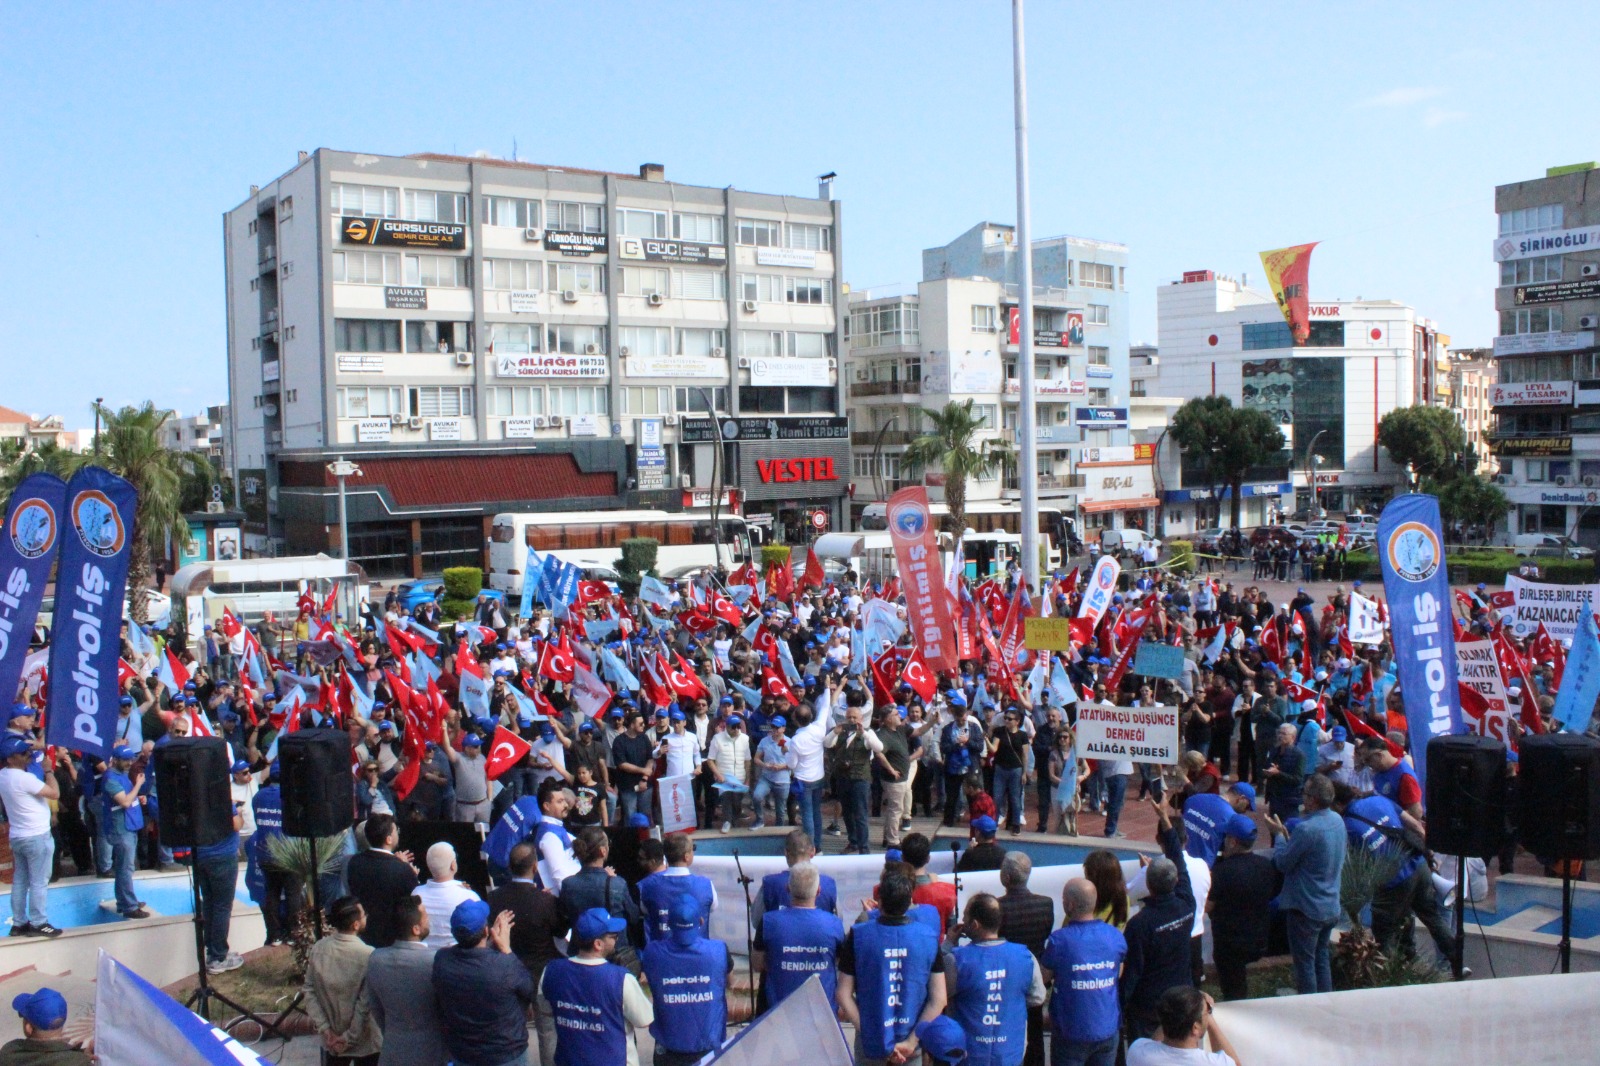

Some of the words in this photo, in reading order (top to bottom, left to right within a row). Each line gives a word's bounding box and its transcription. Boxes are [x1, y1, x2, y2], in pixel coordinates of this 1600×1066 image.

[428, 225, 462, 235] GRUP
[582, 233, 605, 247] İNŞAAT
[1520, 232, 1588, 256] ŞİRİNOĞLU
[646, 242, 677, 256] GÜÇ
[388, 288, 425, 297] AVUKAT
[518, 356, 577, 367] ALİAĞA
[518, 367, 550, 376] SÜRÜCÜ
[552, 368, 579, 376] KURSU
[1525, 383, 1552, 391] LEYLA
[1507, 391, 1524, 400] SAÇ
[1526, 389, 1567, 398] TASARIM
[780, 427, 811, 438] Hamit
[813, 427, 848, 437] ERDEM
[757, 457, 839, 483] VESTEL
[1517, 605, 1593, 624] KAZANACAĞ
[72, 562, 110, 746] petrol-iş
[1459, 648, 1493, 661] OLMAK
[1410, 590, 1454, 736] trol-iş
[1463, 664, 1498, 678] HAKTIR
[1080, 708, 1130, 724] ATATÜRKÇÜ
[1133, 712, 1176, 727] DÜŞÜNCE
[1106, 727, 1145, 742] DERNEĞİ
[1087, 742, 1126, 755] ALİAĞA
[1129, 746, 1169, 758] ŞUBESİ
[783, 945, 829, 954] petrol-iş
[884, 948, 907, 957] SEN
[781, 961, 829, 971] SENDİKASI
[1071, 961, 1115, 972] petrol-iş
[889, 972, 903, 981] KA
[985, 969, 1006, 979] SEN
[662, 976, 711, 986] petrol-iş
[989, 981, 1001, 990] Dİ
[1071, 977, 1115, 990] SENDİKASI
[663, 991, 714, 1004] SENDİKASI
[887, 995, 902, 1006] OL
[987, 993, 1002, 1001] KA
[557, 1000, 602, 1015] petrol-iş
[556, 1017, 605, 1032] SENDİKASI
[982, 1015, 1001, 1025] OL
